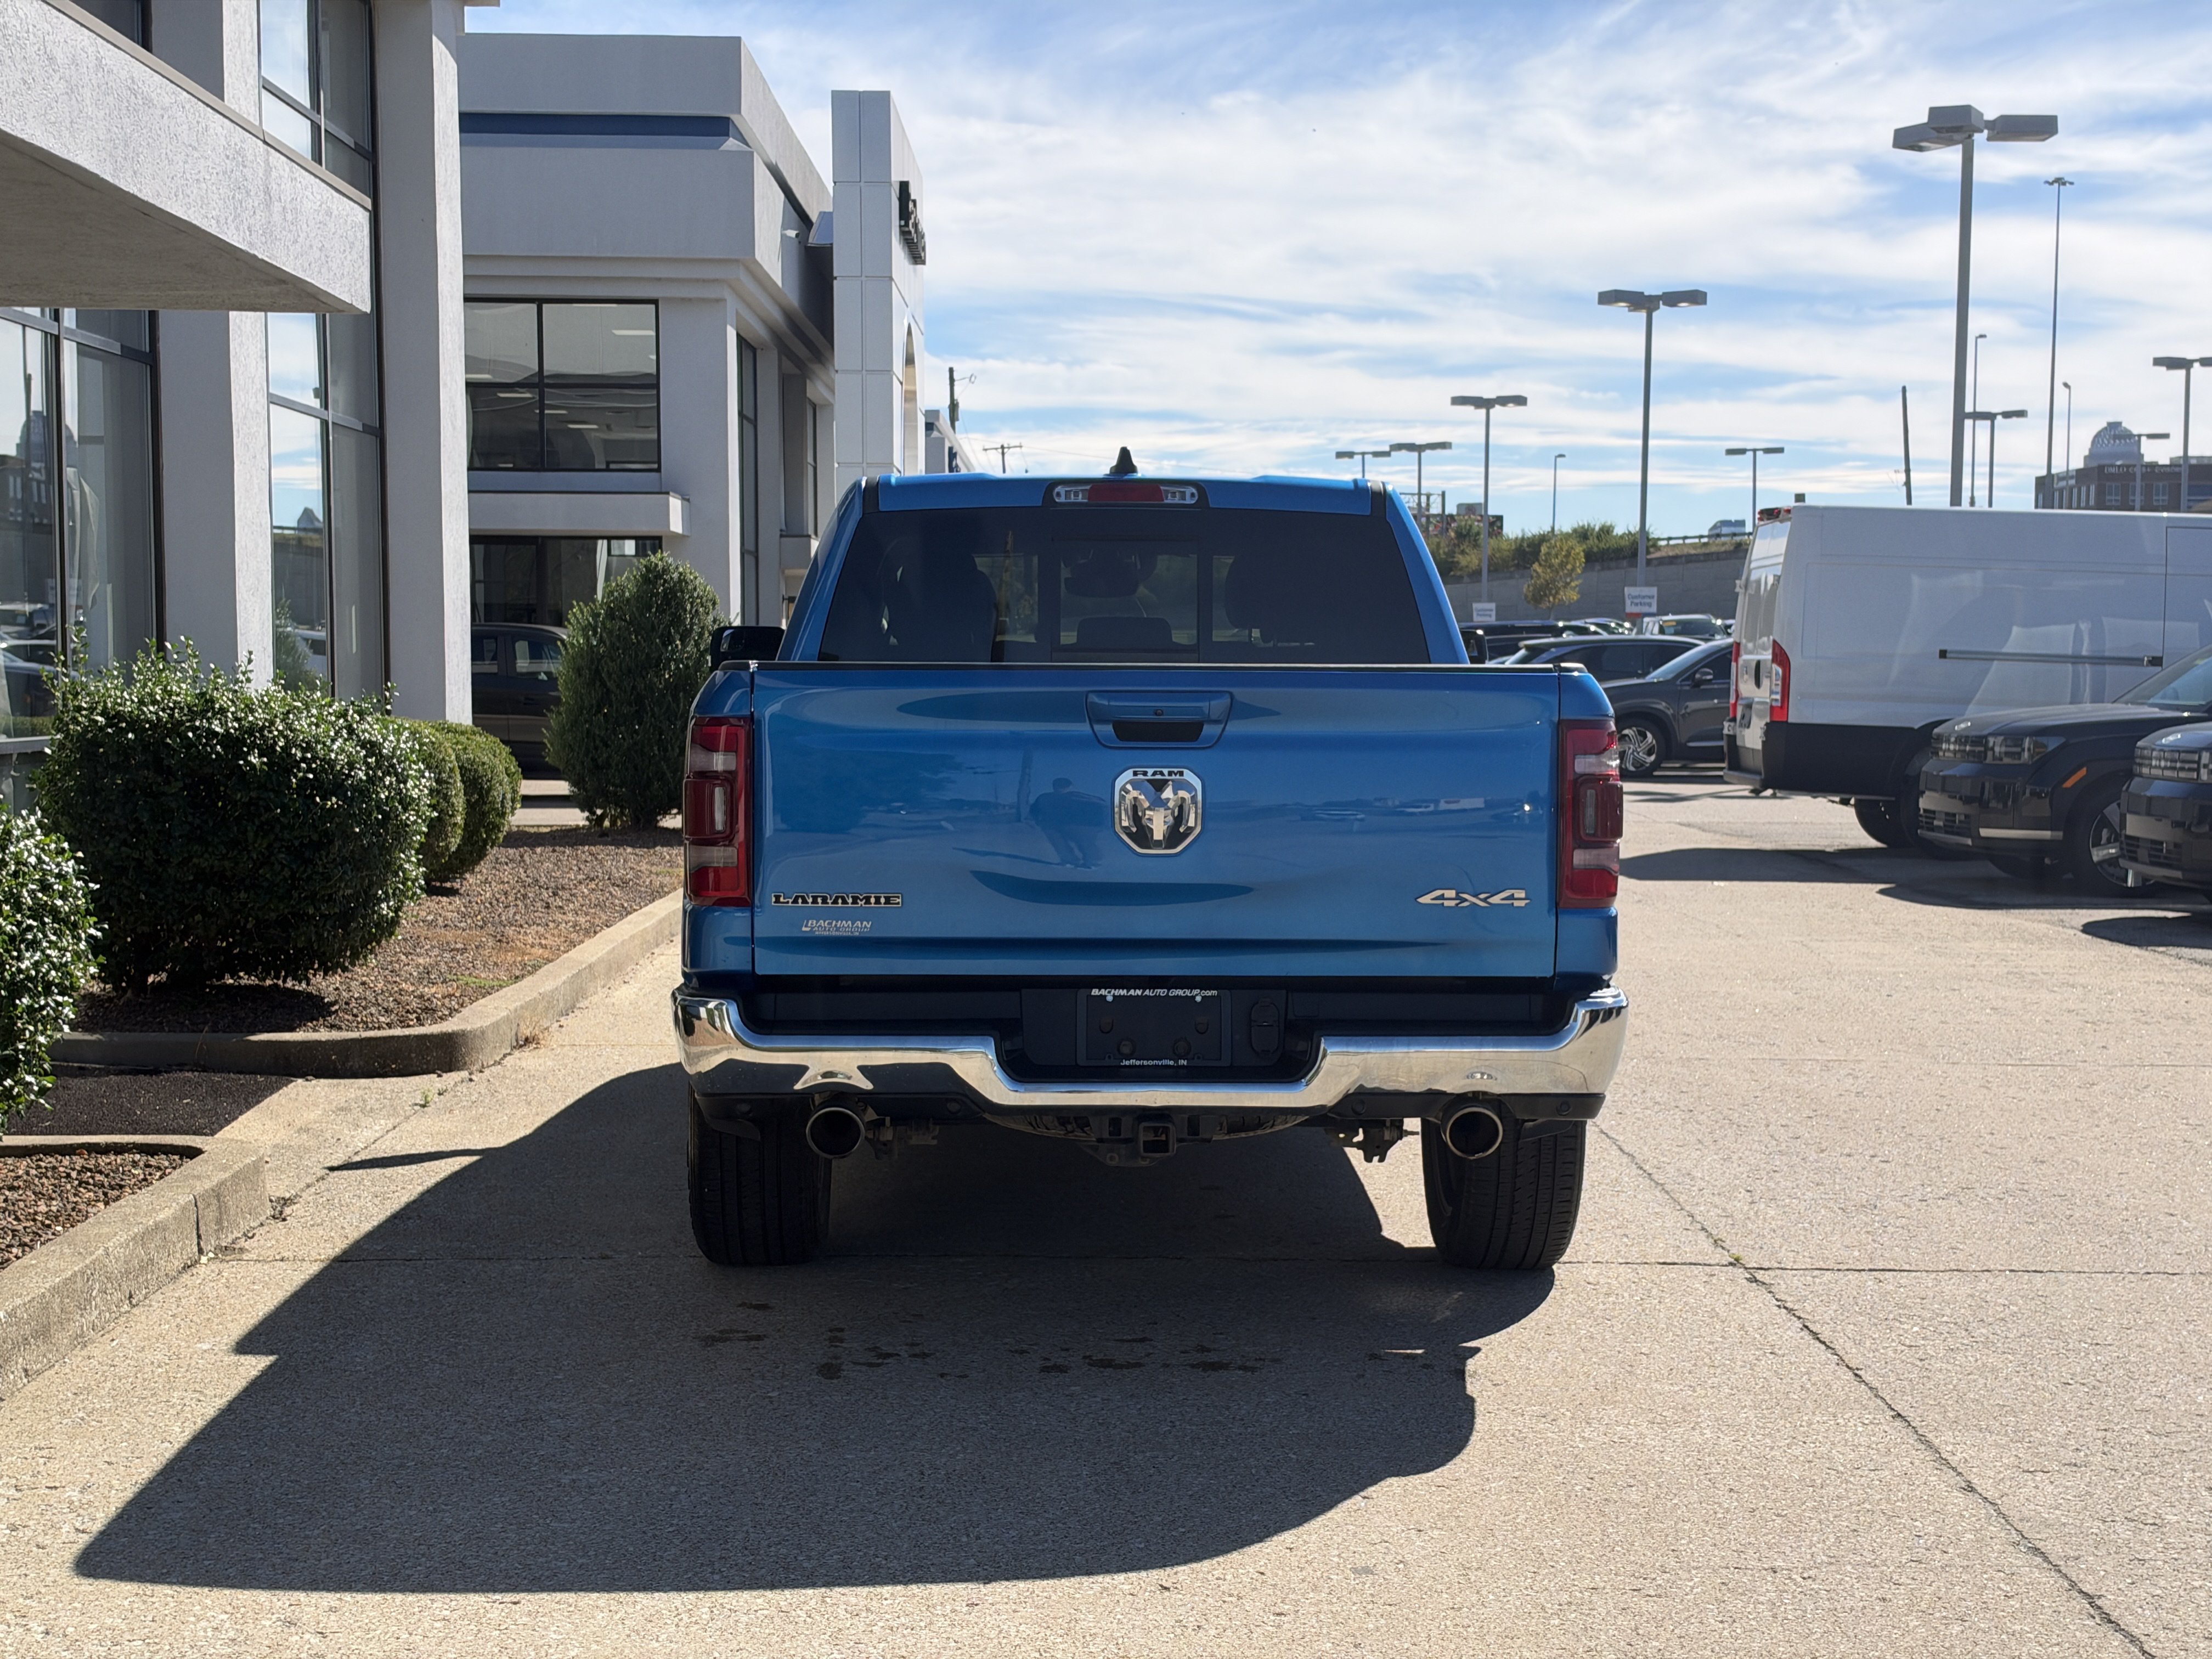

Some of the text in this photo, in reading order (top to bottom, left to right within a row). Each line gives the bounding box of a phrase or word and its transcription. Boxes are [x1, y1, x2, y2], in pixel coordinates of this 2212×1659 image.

[771, 893, 902, 907] LARAMIE
[1416, 889, 1531, 907] 4x4
[808, 919, 872, 928] BACHMAN
